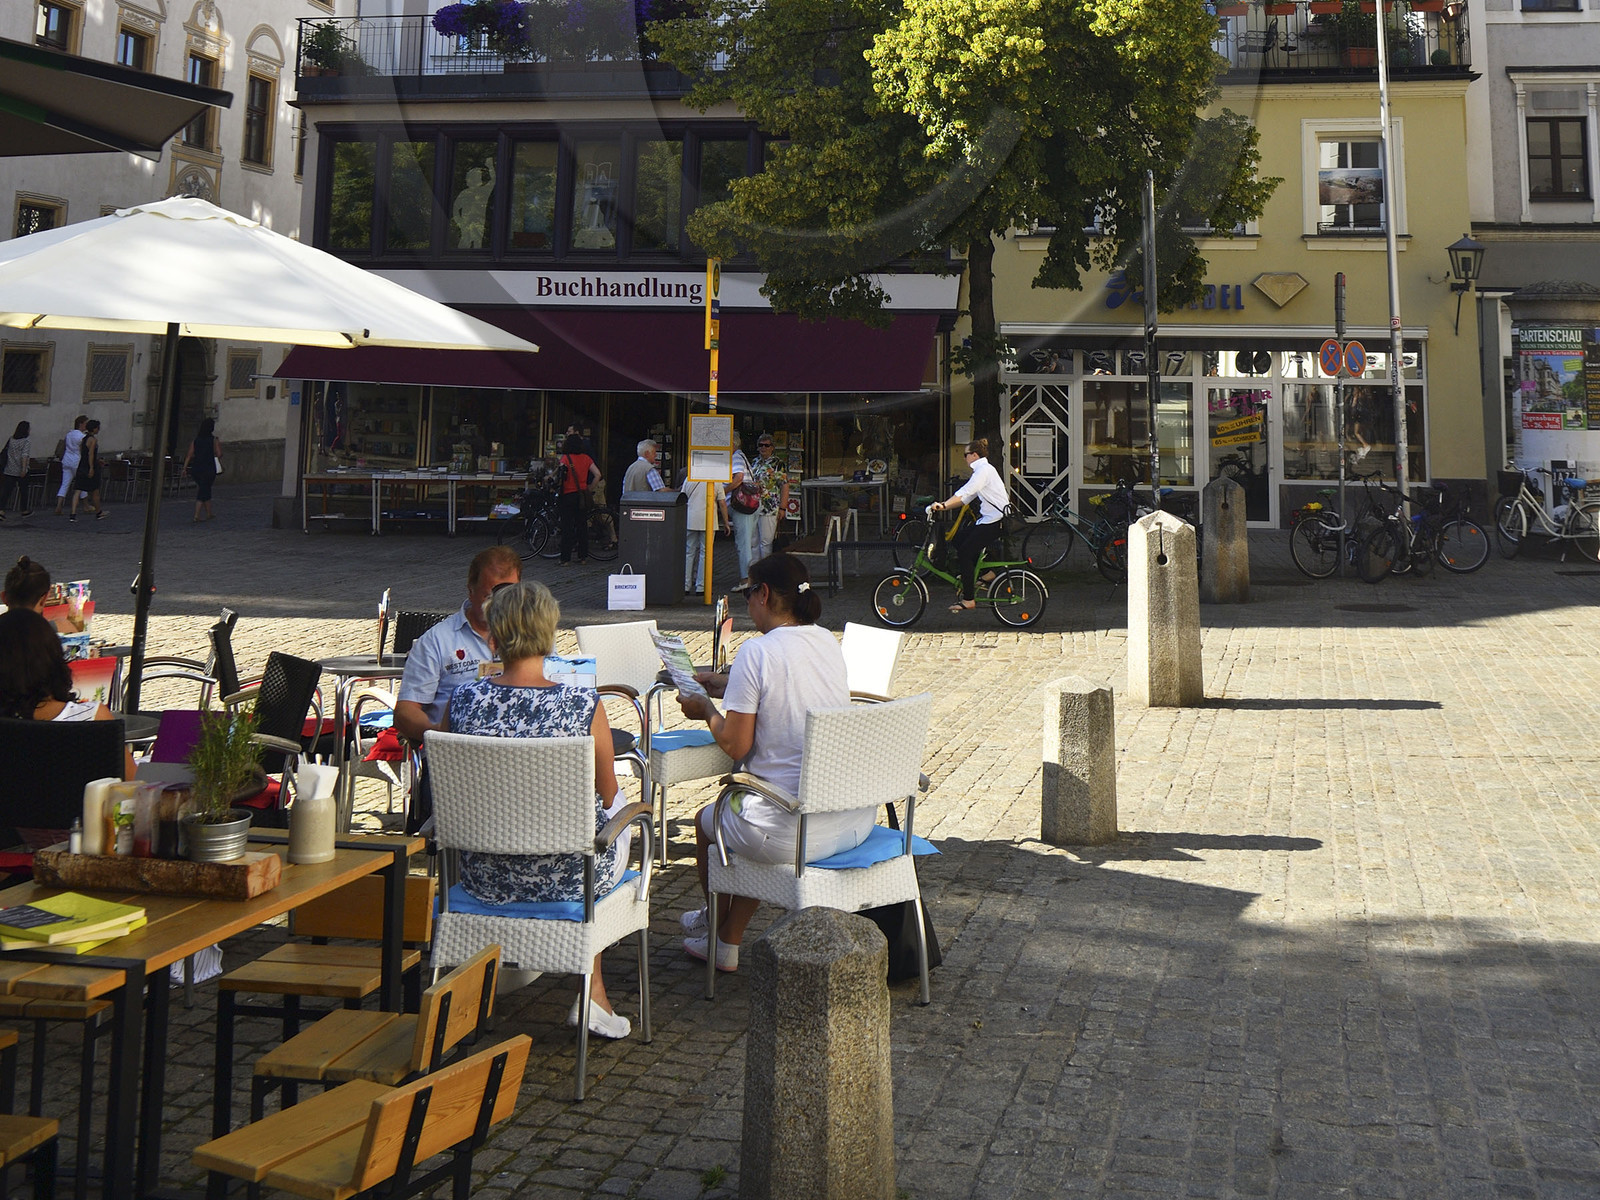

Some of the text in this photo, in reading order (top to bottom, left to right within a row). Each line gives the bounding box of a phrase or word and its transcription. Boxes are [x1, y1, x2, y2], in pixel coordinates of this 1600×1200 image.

[536, 276, 703, 304] Buchhandlung
[1520, 330, 1582, 342] GARTENSCHAU
[1236, 416, 1261, 427] UHREN
[445, 662, 462, 670] WEST
